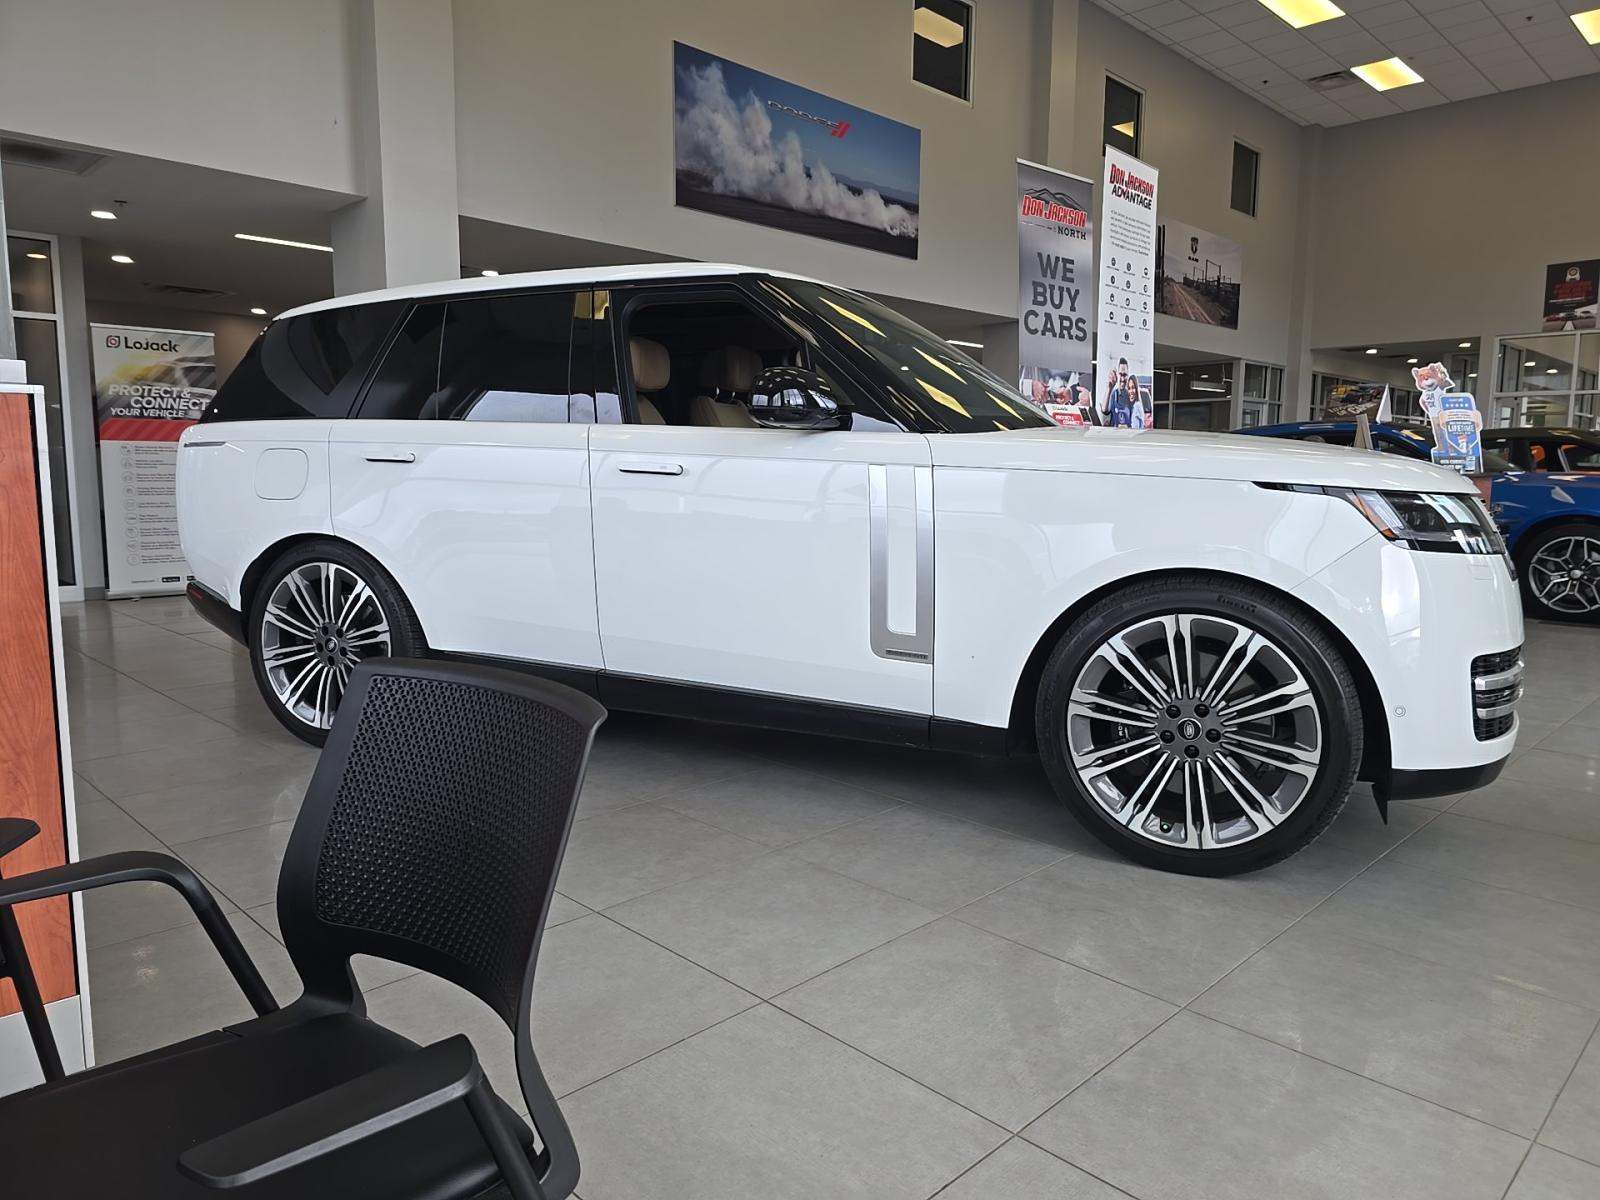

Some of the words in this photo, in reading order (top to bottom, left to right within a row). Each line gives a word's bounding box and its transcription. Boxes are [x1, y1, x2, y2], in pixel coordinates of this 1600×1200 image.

[1110, 163, 1126, 188] DON
[1125, 172, 1155, 199] JACKSON
[1022, 195, 1044, 218] DON
[1044, 201, 1088, 228] JACKSON
[1111, 185, 1153, 210] ADVANTAGE
[1057, 226, 1087, 240] NORTH
[1037, 252, 1075, 283] WE
[1032, 281, 1080, 312] BUY
[1024, 309, 1088, 342] CARS
[108, 384, 178, 398] PROTECT
[180, 388, 191, 399] &
[130, 397, 208, 410] CONNECT
[110, 407, 141, 416] YOUR
[142, 409, 185, 418] VEHICLE
